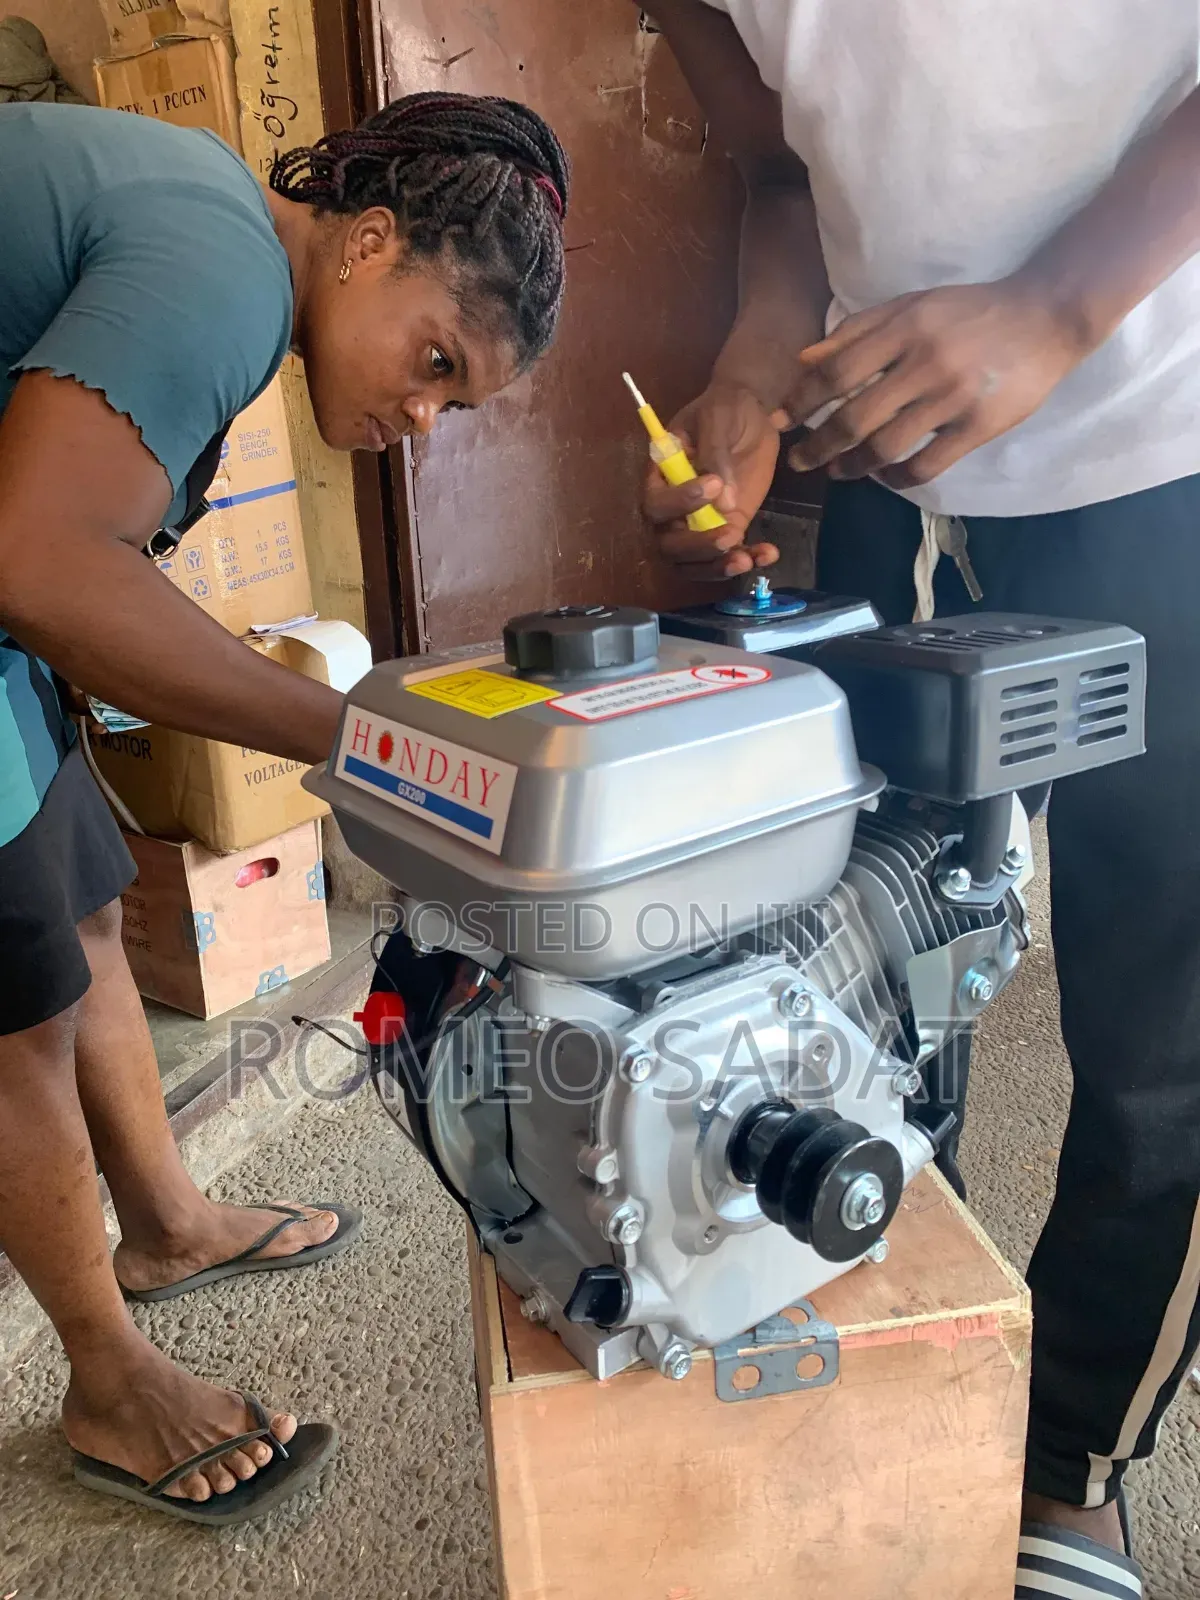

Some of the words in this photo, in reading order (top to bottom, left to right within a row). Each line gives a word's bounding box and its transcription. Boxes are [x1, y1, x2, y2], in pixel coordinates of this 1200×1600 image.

[152, 98, 159, 114] 1
[164, 84, 207, 111] PC/CTN
[237, 427, 271, 442] SISI-250
[239, 438, 268, 452] BENCH
[241, 446, 278, 462] GRINDER
[273, 521, 287, 533] PCS
[255, 541, 269, 554] 15.5
[275, 535, 290, 547] KGS
[260, 557, 268, 566] 17
[278, 548, 293, 560] KGS
[397, 781, 426, 806] GX200
